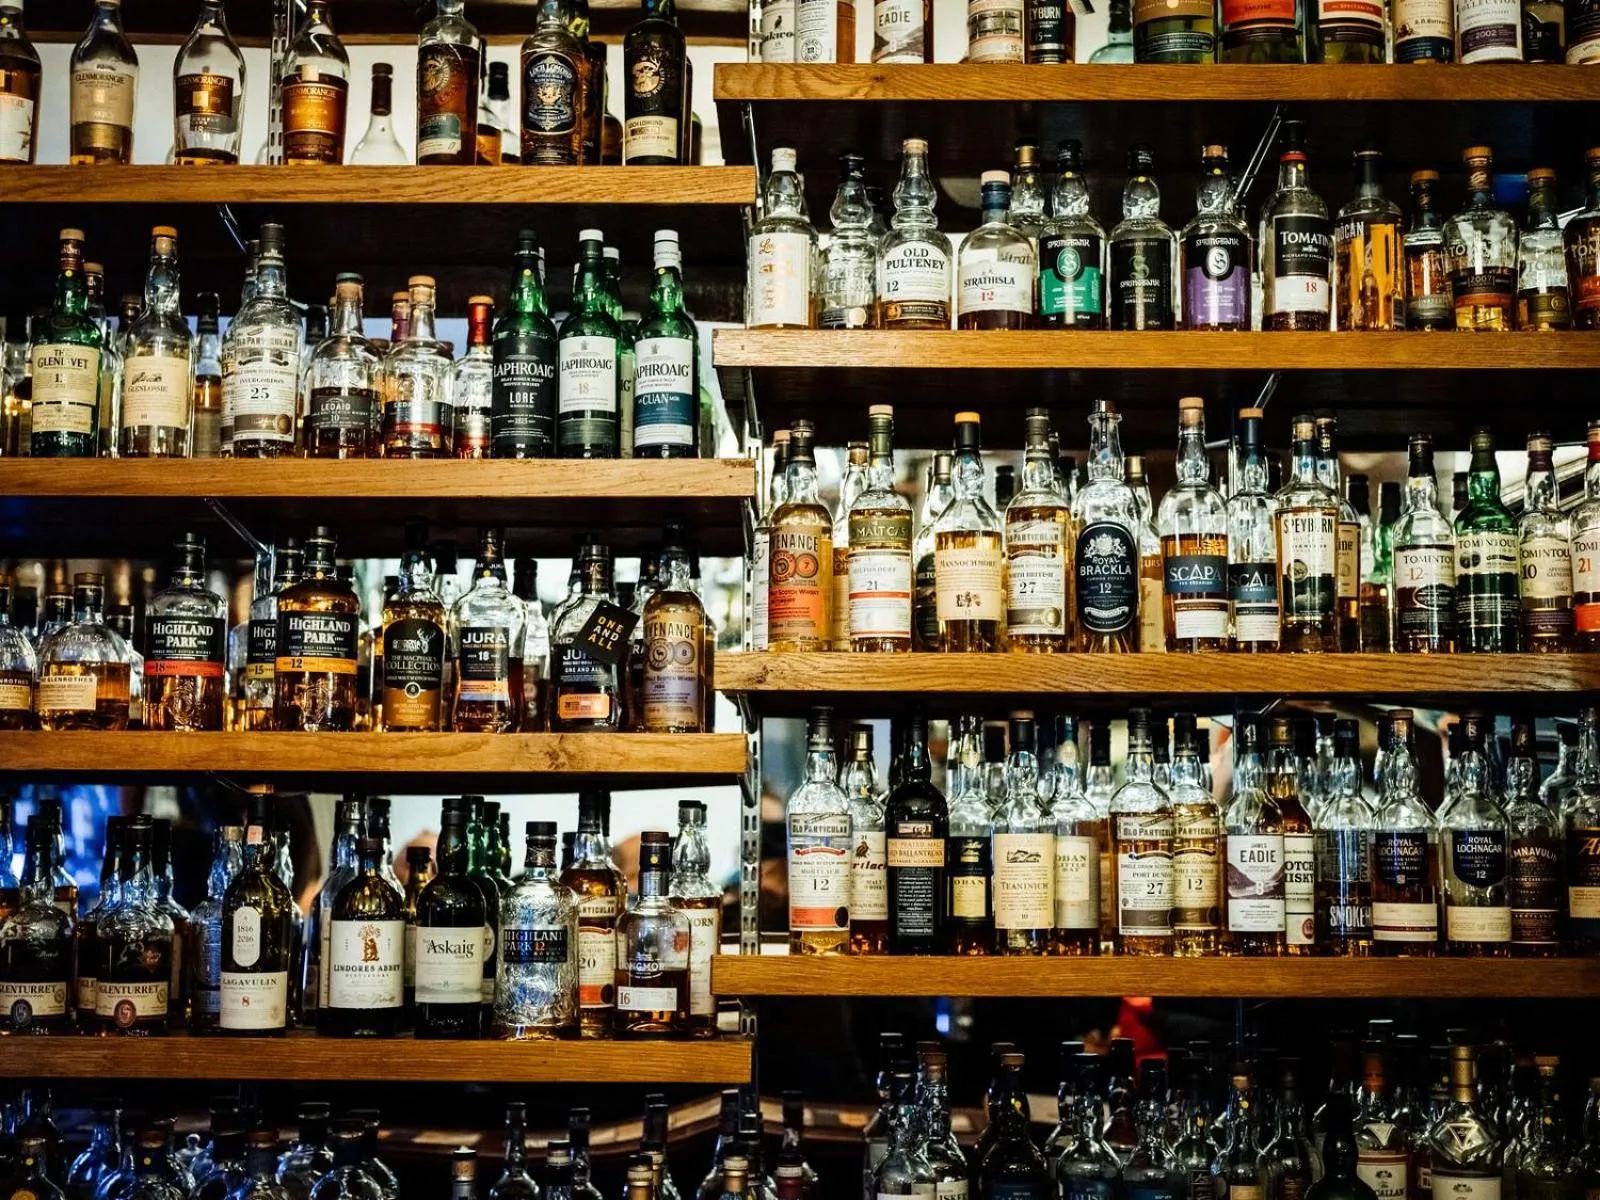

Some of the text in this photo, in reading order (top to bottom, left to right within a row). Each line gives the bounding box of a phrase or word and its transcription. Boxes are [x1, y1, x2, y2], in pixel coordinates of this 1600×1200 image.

[879, 10, 911, 26] EADIE
[1029, 6, 1061, 19] EYBURN
[1474, 29, 1497, 39] 2002
[75, 73, 125, 84] GLENMORANGIE
[1279, 231, 1328, 245] TOMATIN
[903, 248, 929, 257] OLD
[886, 258, 945, 271] PULTENEY
[886, 280, 899, 292] 12
[963, 276, 1016, 288] STRATHISLA
[1305, 281, 1318, 293] 18
[980, 291, 995, 302] 12
[37, 357, 88, 369] GLENLVET
[561, 357, 613, 372] LAPHROAIG
[493, 362, 554, 378] LAPHROAIG
[635, 363, 690, 379] APHROAIG
[250, 387, 270, 400] 25
[577, 382, 590, 394] 18
[509, 392, 535, 404] LORE
[643, 393, 670, 405] CUAN
[857, 526, 886, 537] MALT
[1283, 517, 1333, 534] SPEYBRN
[772, 533, 819, 553] ENANCE
[1520, 547, 1570, 558] OMINTOU
[1092, 555, 1120, 565] ROYAL
[1403, 555, 1453, 564] TOMINTO
[1578, 557, 1592, 573] 21
[804, 562, 810, 570] 7
[1080, 564, 1132, 576] BRACKLA
[1169, 563, 1222, 581] SCAPA
[1521, 563, 1538, 580] 10
[1230, 570, 1275, 587] SCAP
[1409, 567, 1424, 580] 12
[866, 580, 878, 591] 21
[1019, 581, 1036, 594] 27
[1098, 582, 1113, 594] 12
[153, 622, 214, 636] HIGHLAND
[289, 617, 351, 632] HIGHLAND
[598, 615, 624, 633] ONE
[303, 631, 335, 644] PARK
[592, 625, 619, 641] AND
[647, 622, 696, 641] VENANCE
[166, 635, 198, 648] PARK
[462, 632, 506, 644] JURA
[587, 634, 614, 651] ALL
[478, 651, 490, 661] 18
[682, 648, 688, 656] 8
[154, 662, 166, 672] 18
[290, 658, 303, 668] 12
[386, 661, 441, 671] COLLECTION
[254, 664, 265, 675] 15
[804, 824, 848, 834] PARTICULAR
[1388, 838, 1414, 846] ROYAL
[1468, 836, 1493, 844] ROYAL
[1378, 847, 1424, 857] LOCHNAGAR
[1456, 844, 1503, 853] LOCHNAGAR
[1510, 846, 1558, 863] MNAVULIN
[1240, 850, 1277, 863] EADIE
[852, 861, 887, 870] rtlac
[1284, 860, 1314, 871] OTCH
[1475, 870, 1487, 879] 12
[812, 878, 830, 891] 12
[953, 878, 985, 886] OBAN
[1000, 882, 1049, 890] TEANINICH
[1187, 878, 1203, 890] 12
[1146, 882, 1164, 895] 27
[580, 906, 615, 915] ARTICULAR
[427, 939, 475, 959] Askaig
[503, 941, 546, 952] PARK 12
[333, 964, 401, 973] LINDORES ABBEY
[579, 957, 597, 969] 20
[221, 977, 278, 986] LAGAVULIN
[0, 985, 57, 995] LENTURRET
[241, 995, 250, 1007] 8
[619, 992, 631, 1005] 16
